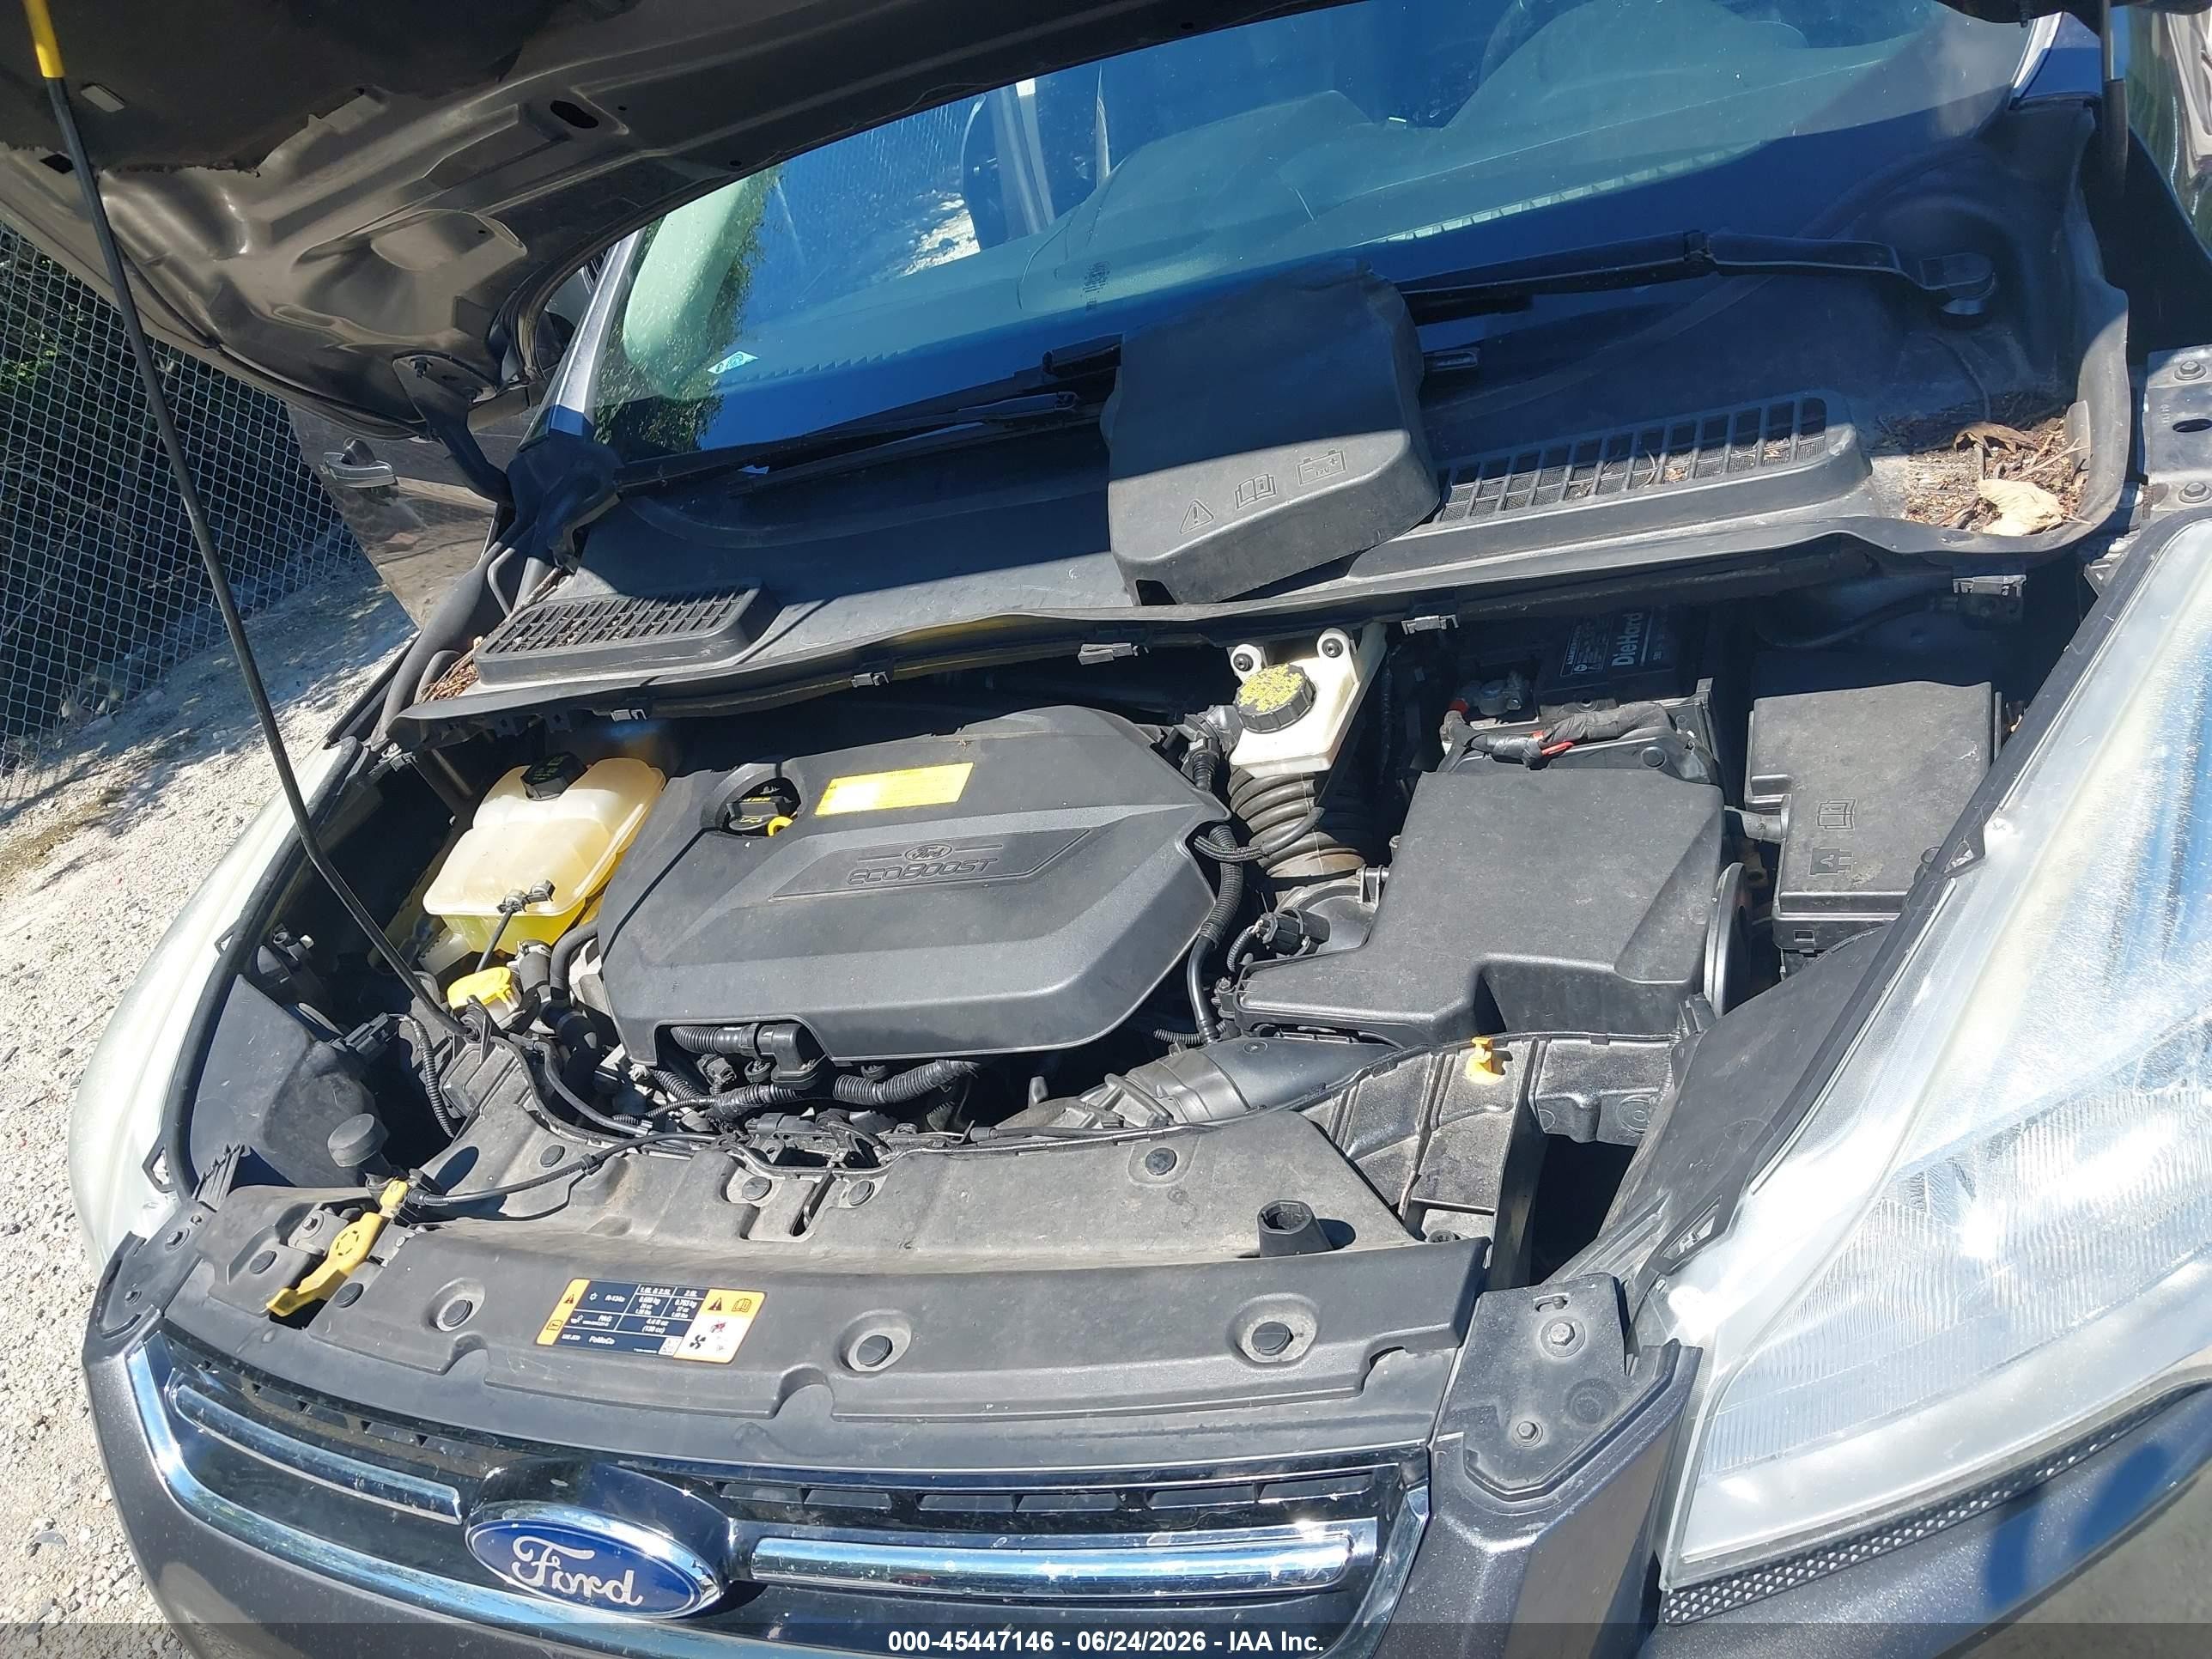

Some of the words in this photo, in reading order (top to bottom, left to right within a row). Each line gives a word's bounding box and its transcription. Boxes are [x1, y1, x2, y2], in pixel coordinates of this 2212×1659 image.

[1611, 611, 1644, 666] DieHard
[912, 844, 945, 860] Ford
[511, 1535, 644, 1607] Ford
